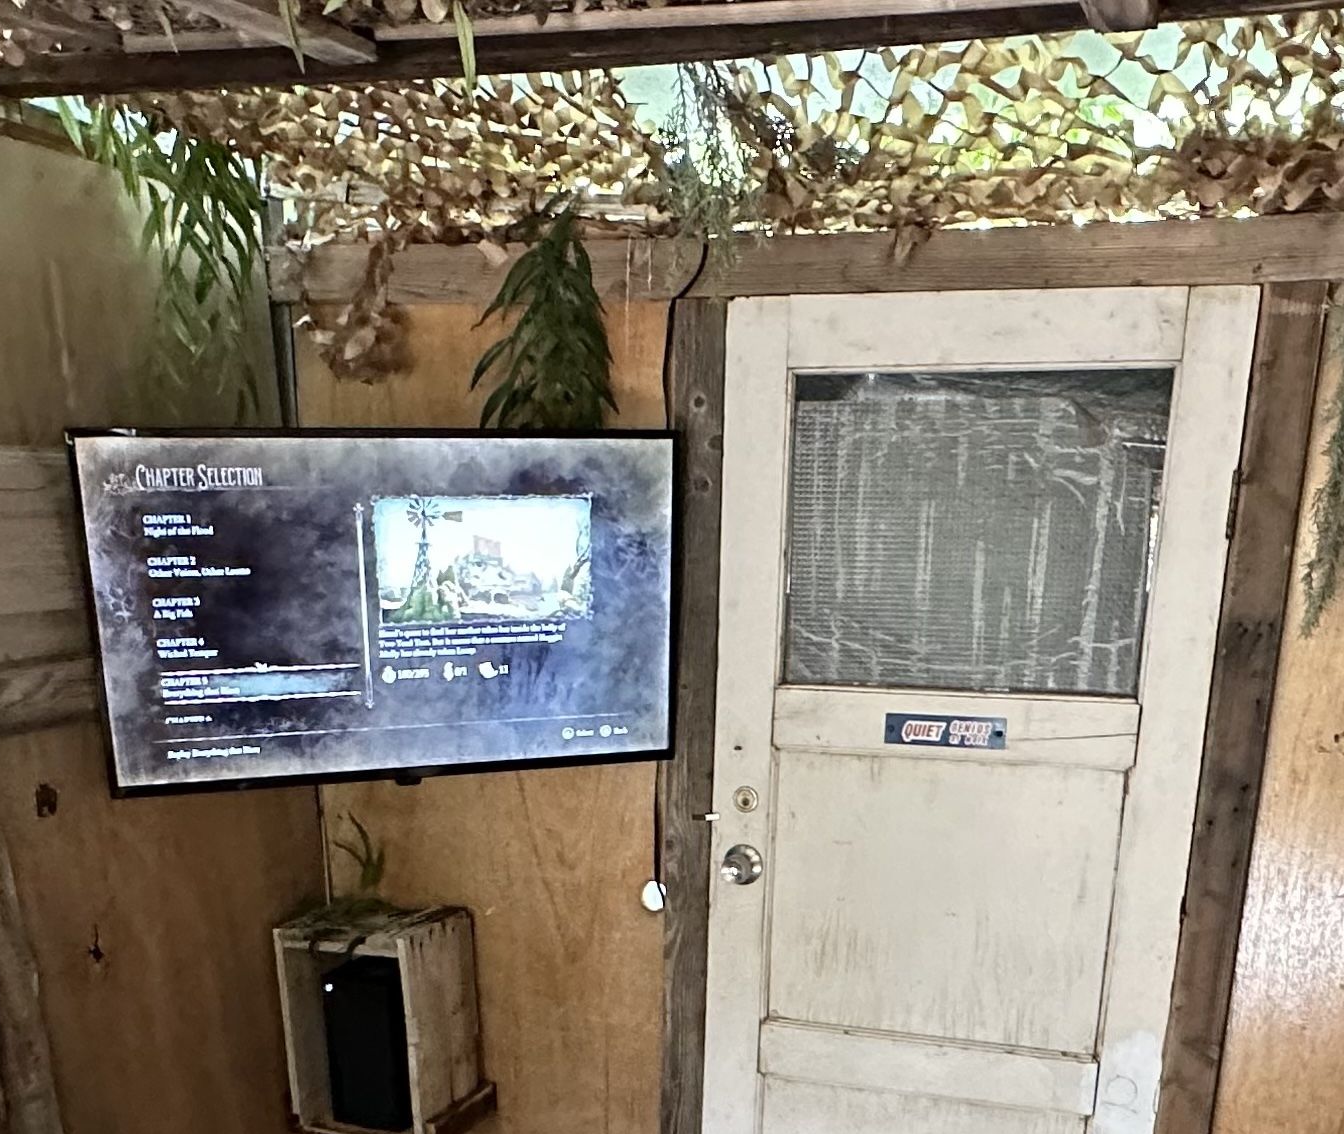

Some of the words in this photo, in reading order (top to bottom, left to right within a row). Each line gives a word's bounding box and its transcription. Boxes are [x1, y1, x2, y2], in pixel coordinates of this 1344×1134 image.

[135, 464, 195, 490] CHAPTER
[197, 464, 263, 490] SELECTION
[142, 515, 186, 524] CHAPTER
[187, 514, 191, 524] 1
[147, 557, 189, 566] CHAPTER
[190, 556, 196, 565] 2
[152, 598, 193, 607] CHAPTER
[194, 596, 200, 606] 3
[157, 638, 197, 647] CHAPTER
[160, 677, 202, 686] CHAPTER
[904, 722, 944, 740] QUIET
